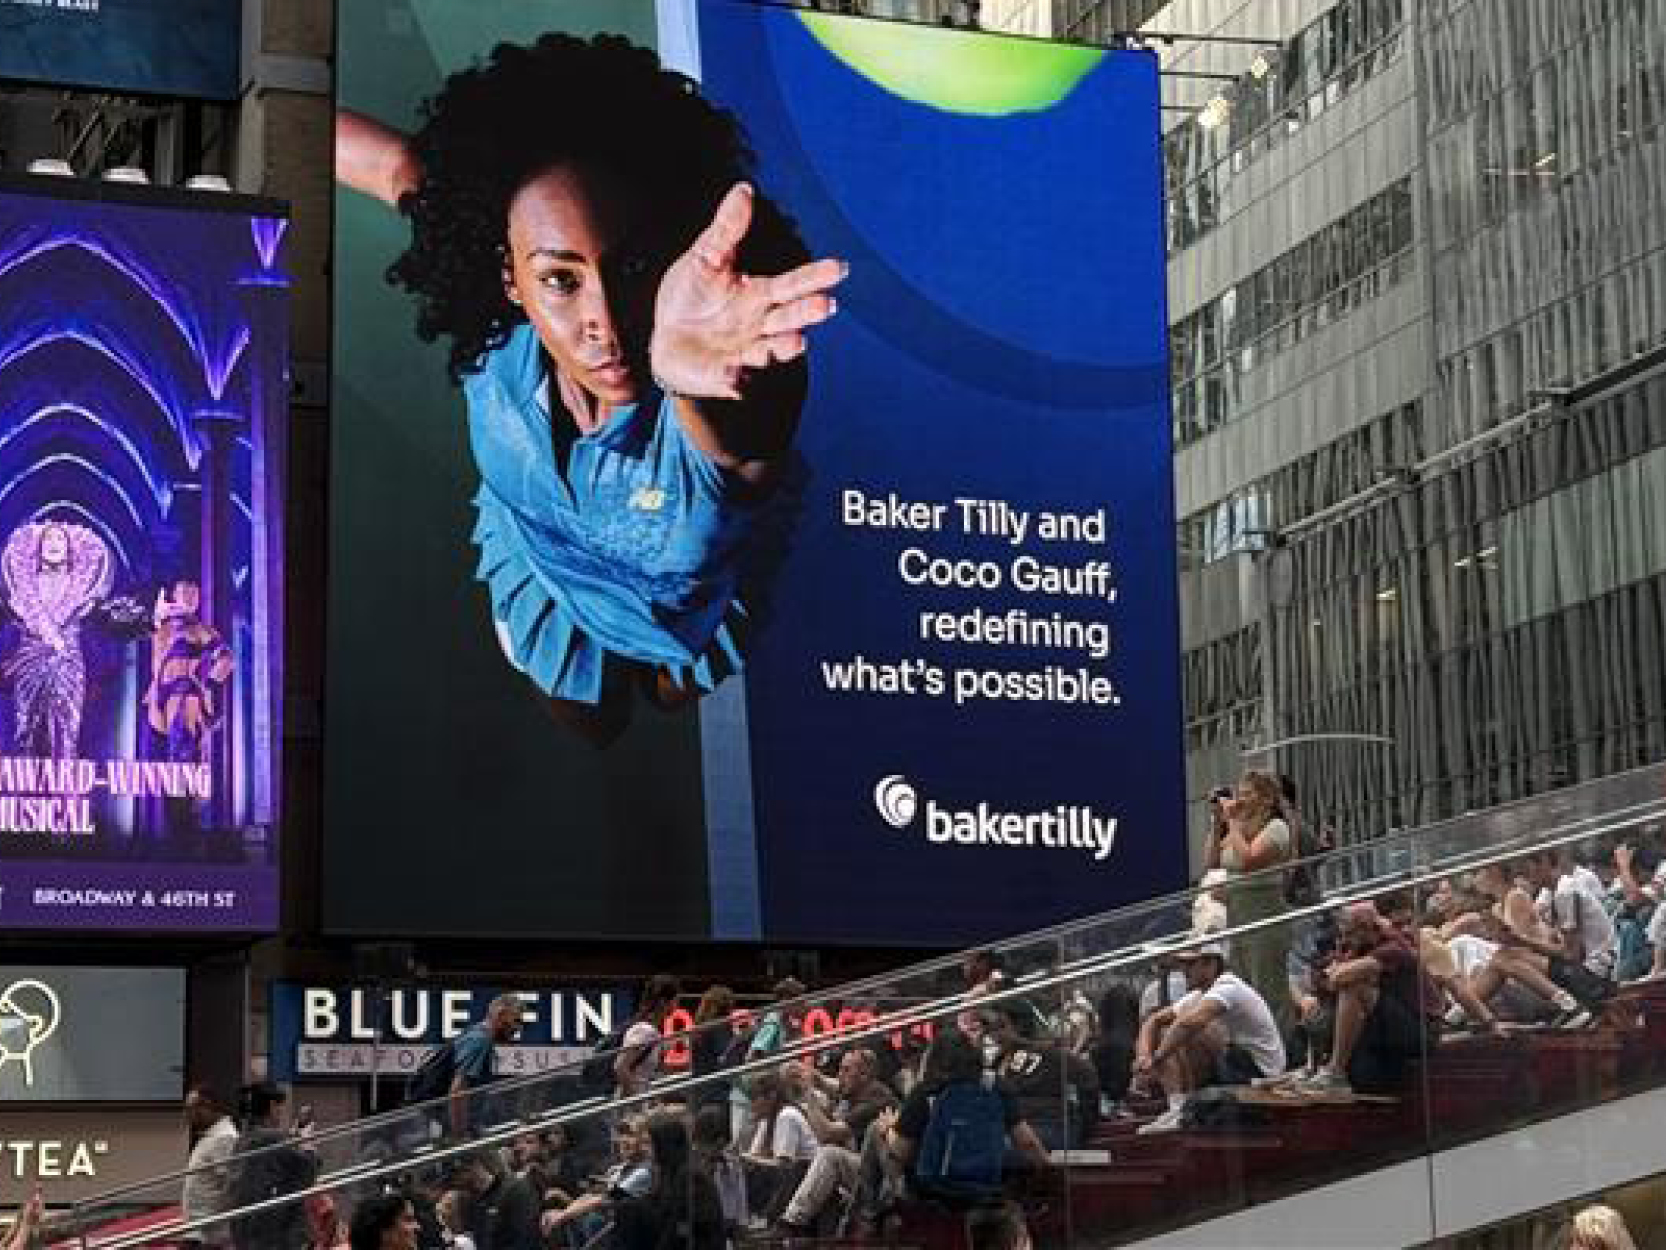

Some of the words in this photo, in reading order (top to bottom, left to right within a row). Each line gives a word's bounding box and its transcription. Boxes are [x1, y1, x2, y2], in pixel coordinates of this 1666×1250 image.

[842, 489, 947, 532] Baker
[954, 497, 1030, 546] Tilly
[1038, 508, 1106, 544] and
[899, 548, 1001, 589] Coco
[1011, 556, 1118, 603] Gauff,
[920, 607, 1110, 659] redefining
[821, 655, 946, 696] what's
[954, 665, 1122, 705] possible.
[925, 800, 1119, 861] bakertilly
[213, 890, 237, 908] ST
[304, 987, 474, 1040] BLUE
[303, 1049, 417, 1071] SEAFO
